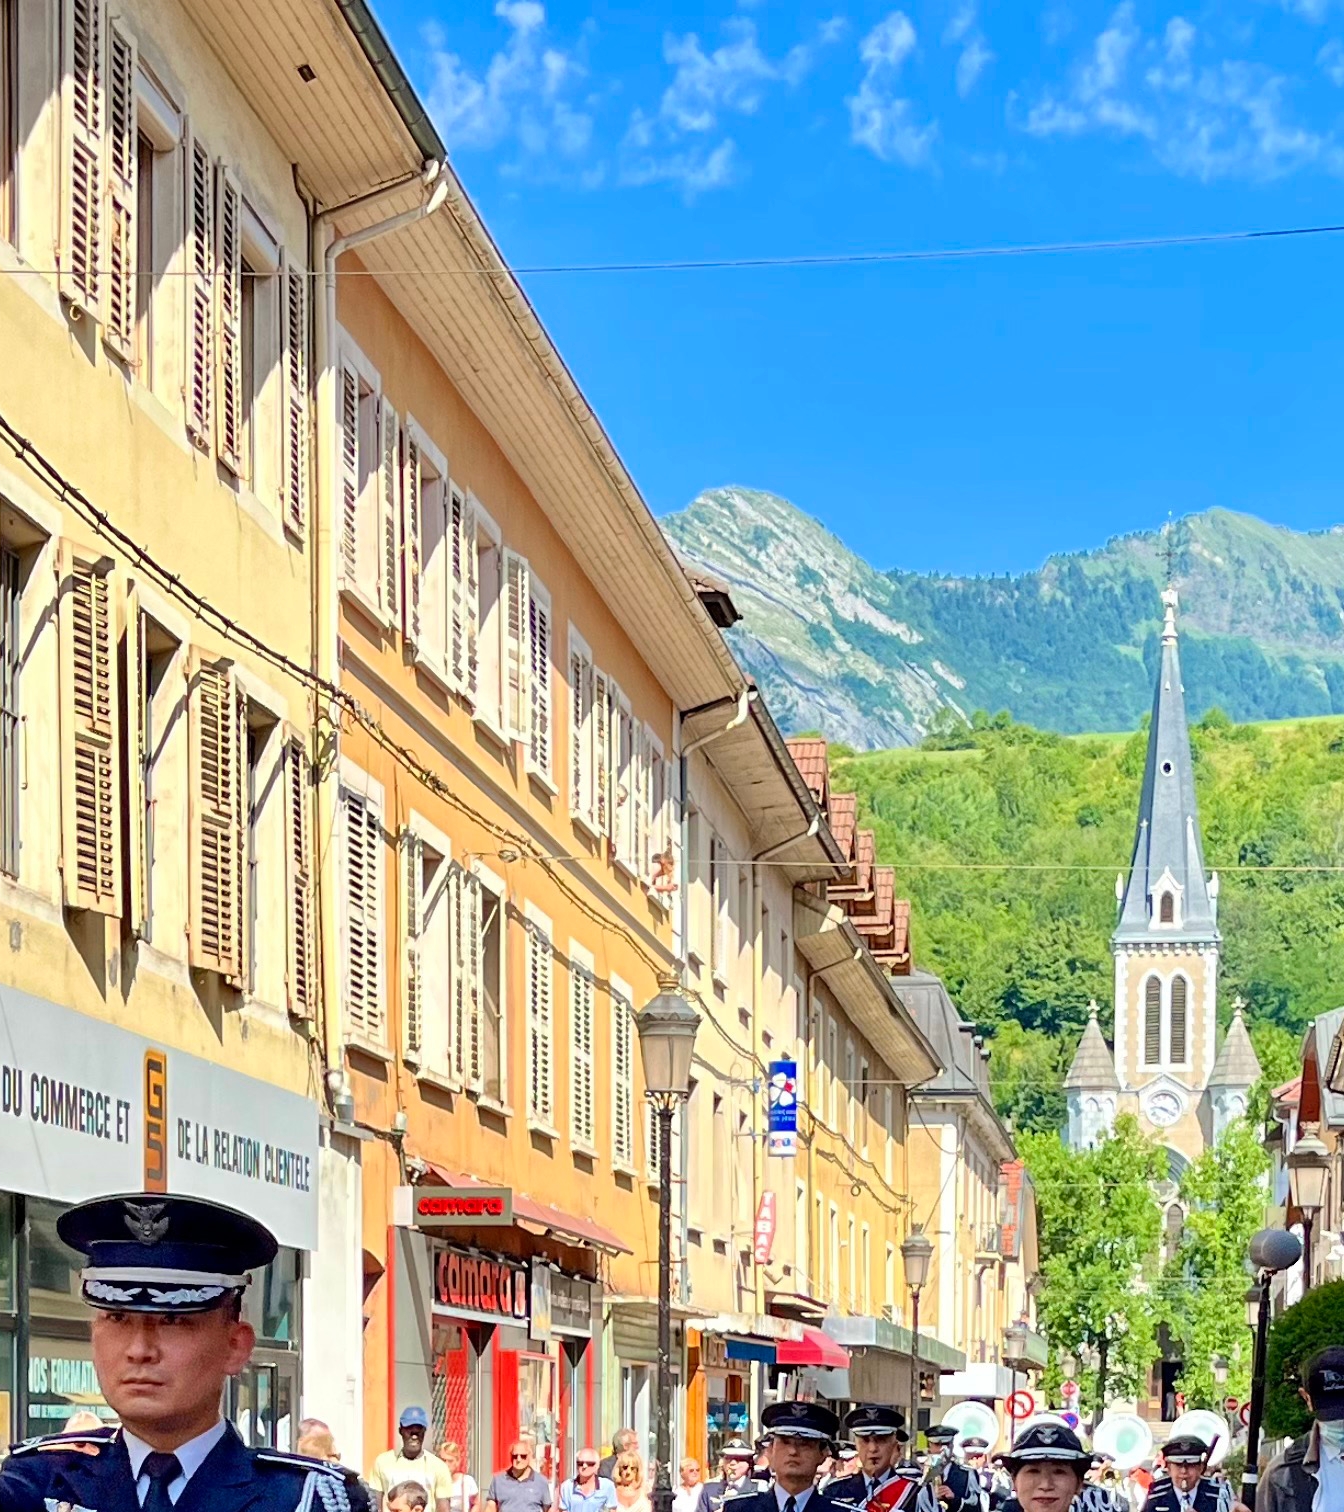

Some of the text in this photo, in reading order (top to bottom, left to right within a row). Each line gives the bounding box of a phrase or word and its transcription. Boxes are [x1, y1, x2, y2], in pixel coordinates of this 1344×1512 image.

[2, 1065, 22, 1117] DU
[30, 1072, 110, 1139] COMMERCE
[117, 1099, 131, 1144] ET
[178, 1117, 191, 1161] DE
[195, 1123, 209, 1166] LA
[214, 1129, 260, 1180] RELATION
[417, 1196, 504, 1216] camara
[757, 1191, 773, 1263] TABAC
[438, 1251, 512, 1313] camara
